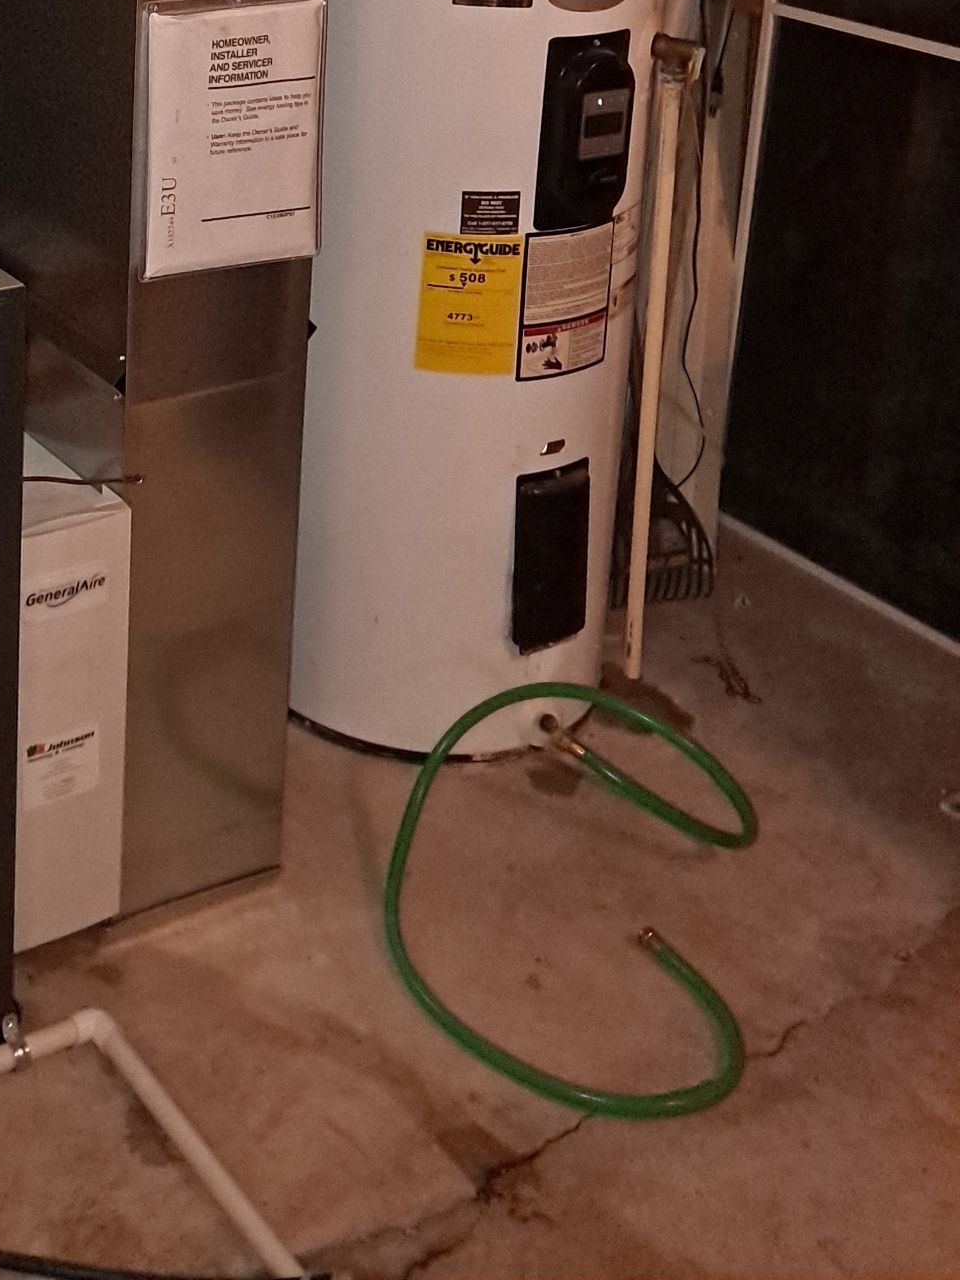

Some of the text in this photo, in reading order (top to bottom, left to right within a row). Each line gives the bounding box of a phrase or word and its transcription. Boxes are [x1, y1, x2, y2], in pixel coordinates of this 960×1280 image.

[211, 34, 271, 50] HOMEOWNER,
[210, 47, 258, 61] INSTALLER
[209, 57, 273, 72] AND SERVICER
[208, 70, 269, 84] INFORMATION
[160, 177, 178, 217] E3U
[449, 271, 486, 284] $ 508
[447, 312, 474, 321] 4773
[25, 576, 106, 607] GeneralAire
